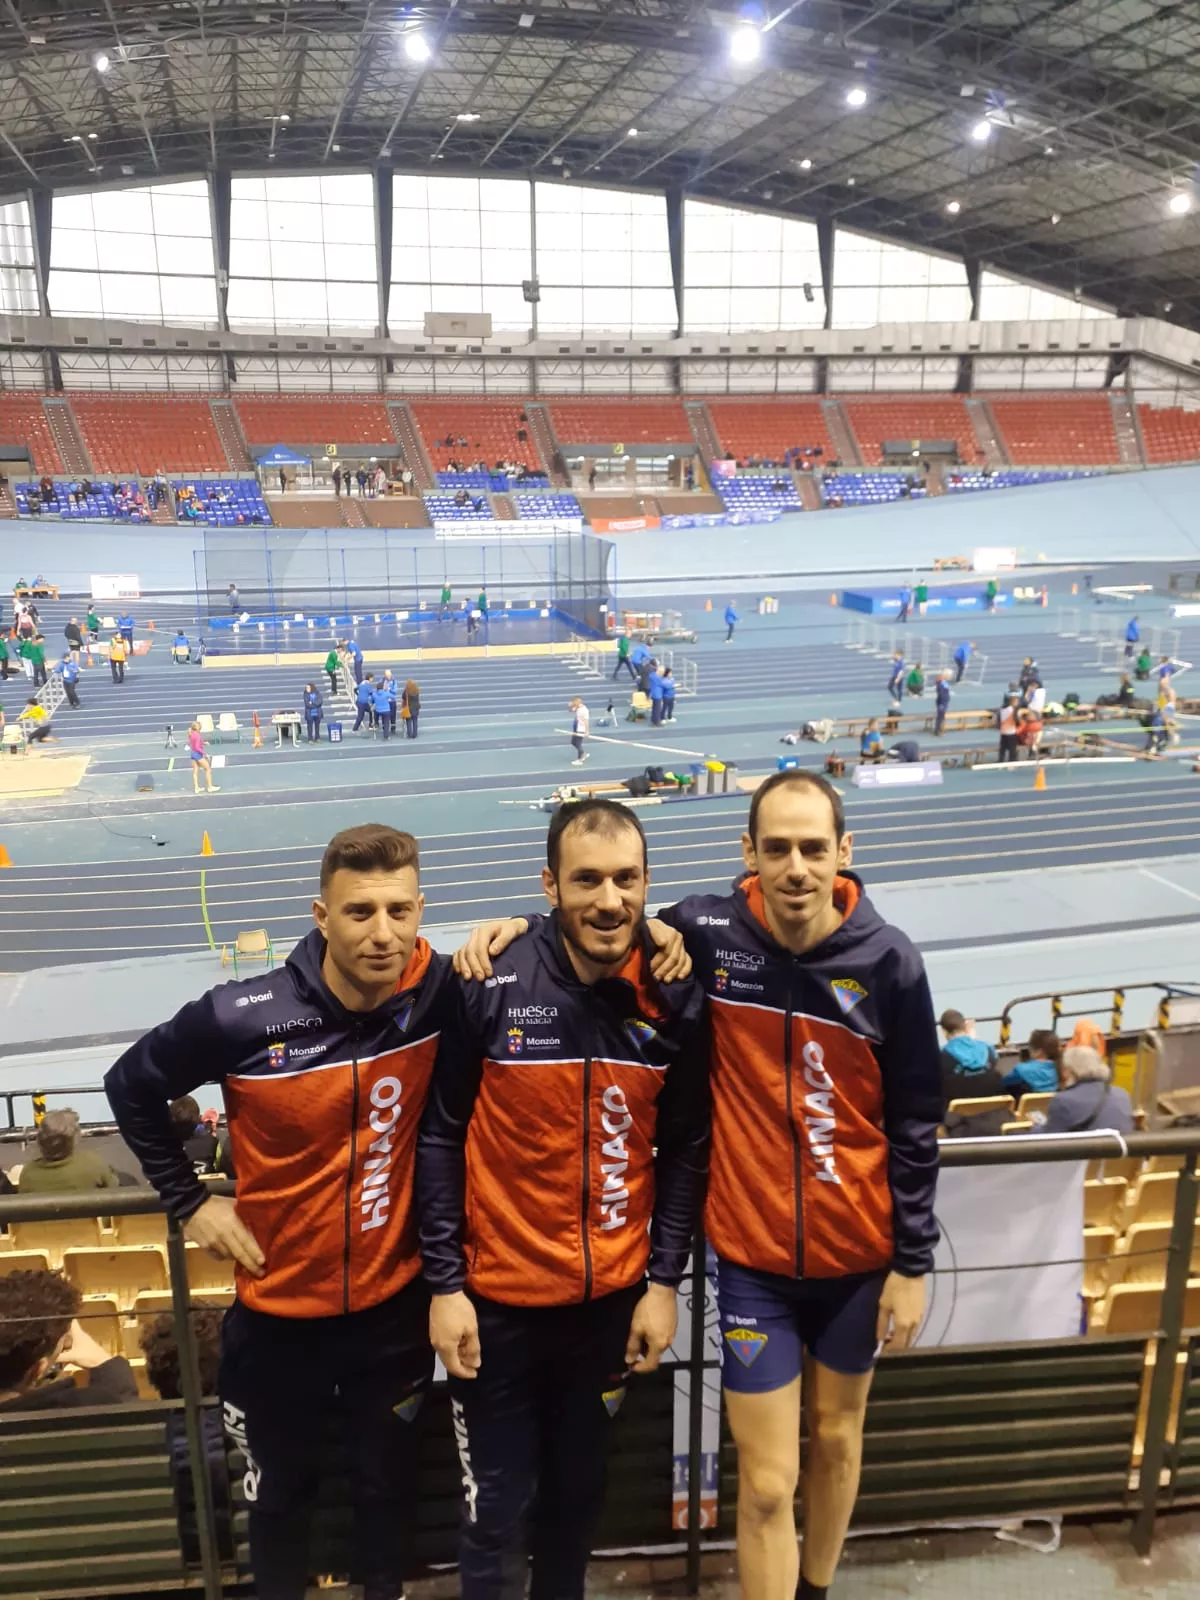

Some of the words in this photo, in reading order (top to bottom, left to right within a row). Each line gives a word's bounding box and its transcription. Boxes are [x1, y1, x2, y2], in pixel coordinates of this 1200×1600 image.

[715, 948, 765, 965] Huesca
[731, 979, 764, 991] Monzón
[249, 990, 274, 1004] barri
[508, 1005, 558, 1018] Huesca
[266, 1017, 323, 1036] Huesca
[526, 1036, 561, 1046] Monzón
[289, 1043, 327, 1057] Monzón
[802, 1040, 842, 1185] HINACO
[361, 1076, 402, 1232] HINACO
[600, 1084, 633, 1231] HINACO
